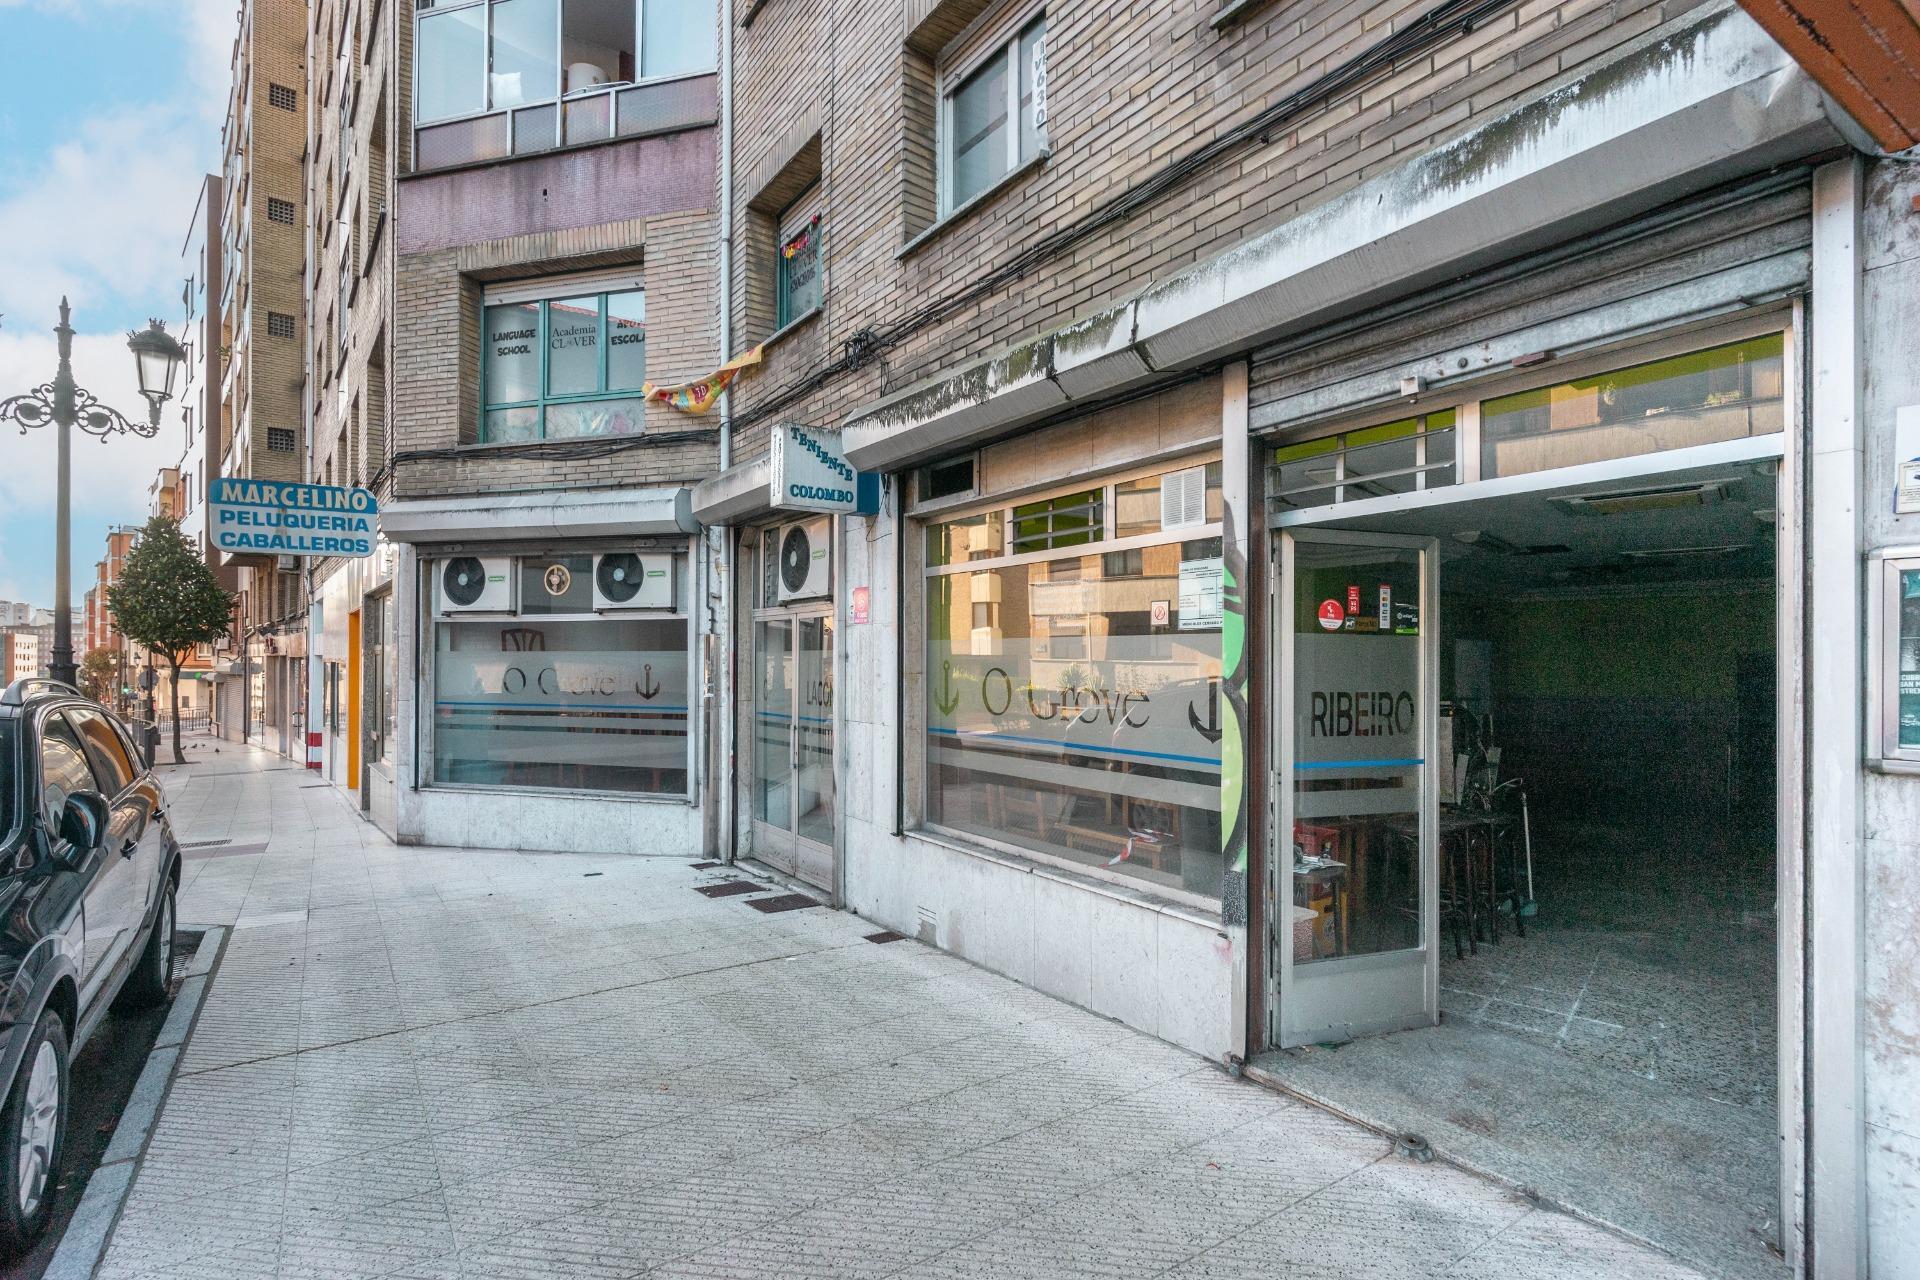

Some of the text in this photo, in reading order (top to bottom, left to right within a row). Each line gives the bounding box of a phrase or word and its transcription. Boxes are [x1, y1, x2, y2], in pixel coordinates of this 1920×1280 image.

[492, 328, 536, 343] LANGUAGE
[552, 323, 596, 338] Academia
[497, 345, 532, 357] SCHOOL
[790, 426, 853, 482] TENIENTE
[220, 481, 368, 511] MARCELINO
[789, 484, 854, 503] COLOMBO
[219, 509, 370, 533] PELUQUERIA
[219, 531, 370, 553] CABALLEROS
[981, 666, 1150, 729] O Grove
[1310, 690, 1415, 738] RIBEIRO
